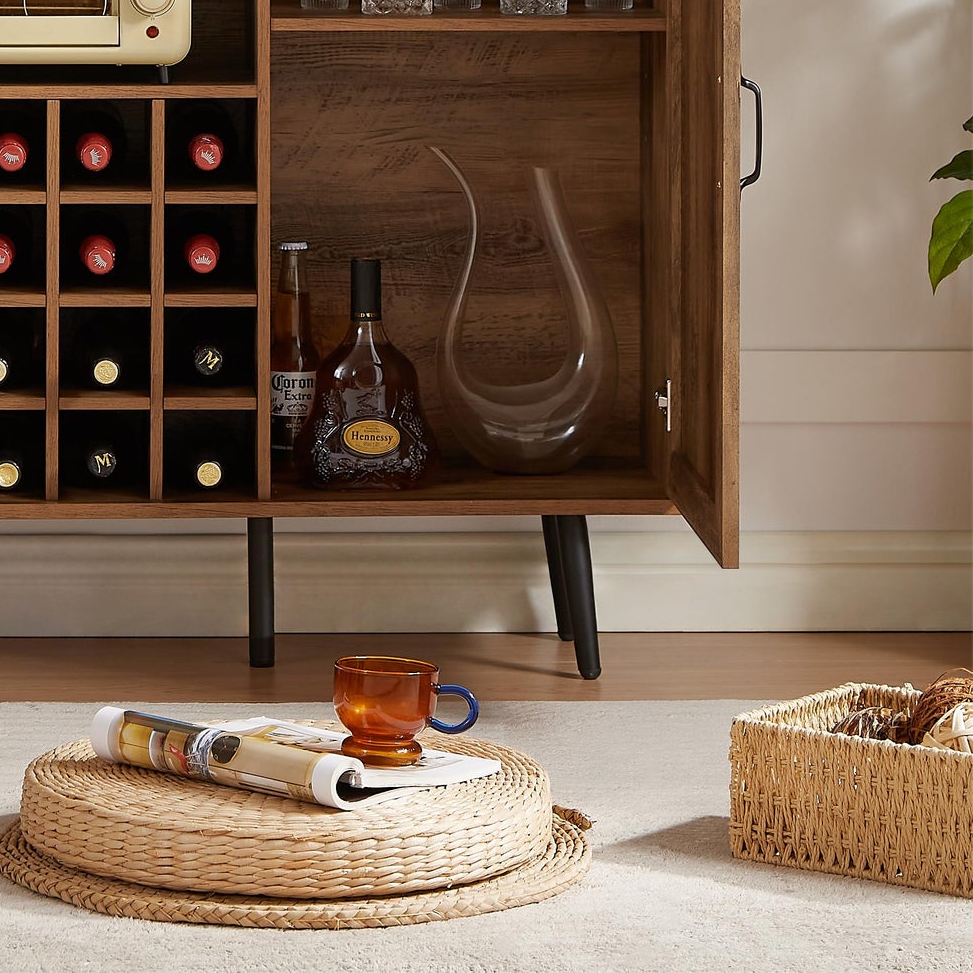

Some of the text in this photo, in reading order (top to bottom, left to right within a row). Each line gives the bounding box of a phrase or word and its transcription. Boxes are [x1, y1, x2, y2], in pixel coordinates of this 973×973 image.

[198, 350, 220, 370] M
[284, 390, 312, 401] Extra
[351, 430, 394, 445] Hennessy
[94, 452, 112, 474] M
